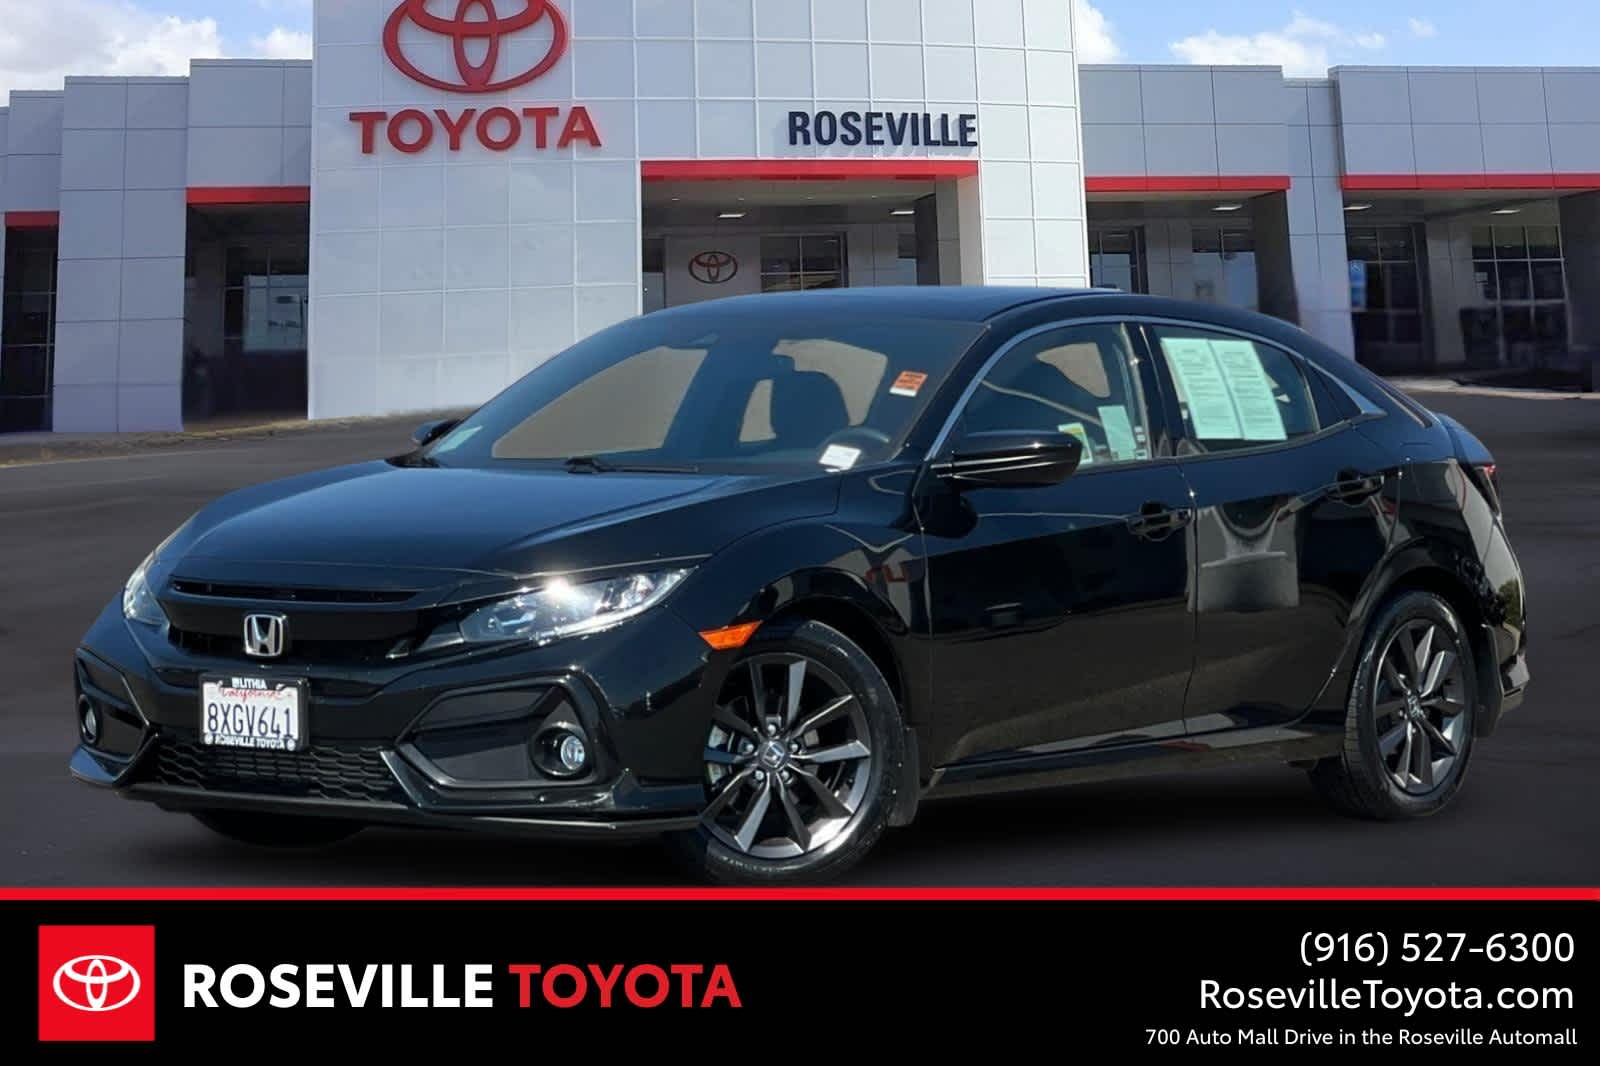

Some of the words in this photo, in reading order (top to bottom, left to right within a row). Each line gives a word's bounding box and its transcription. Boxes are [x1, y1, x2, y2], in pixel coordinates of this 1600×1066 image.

[349, 105, 602, 154] TOYOTA
[788, 110, 978, 148] ROSEVILLE
[240, 678, 267, 690] LITHIA
[208, 703, 293, 738] 8XGV641
[256, 738, 286, 750] TOYOTA
